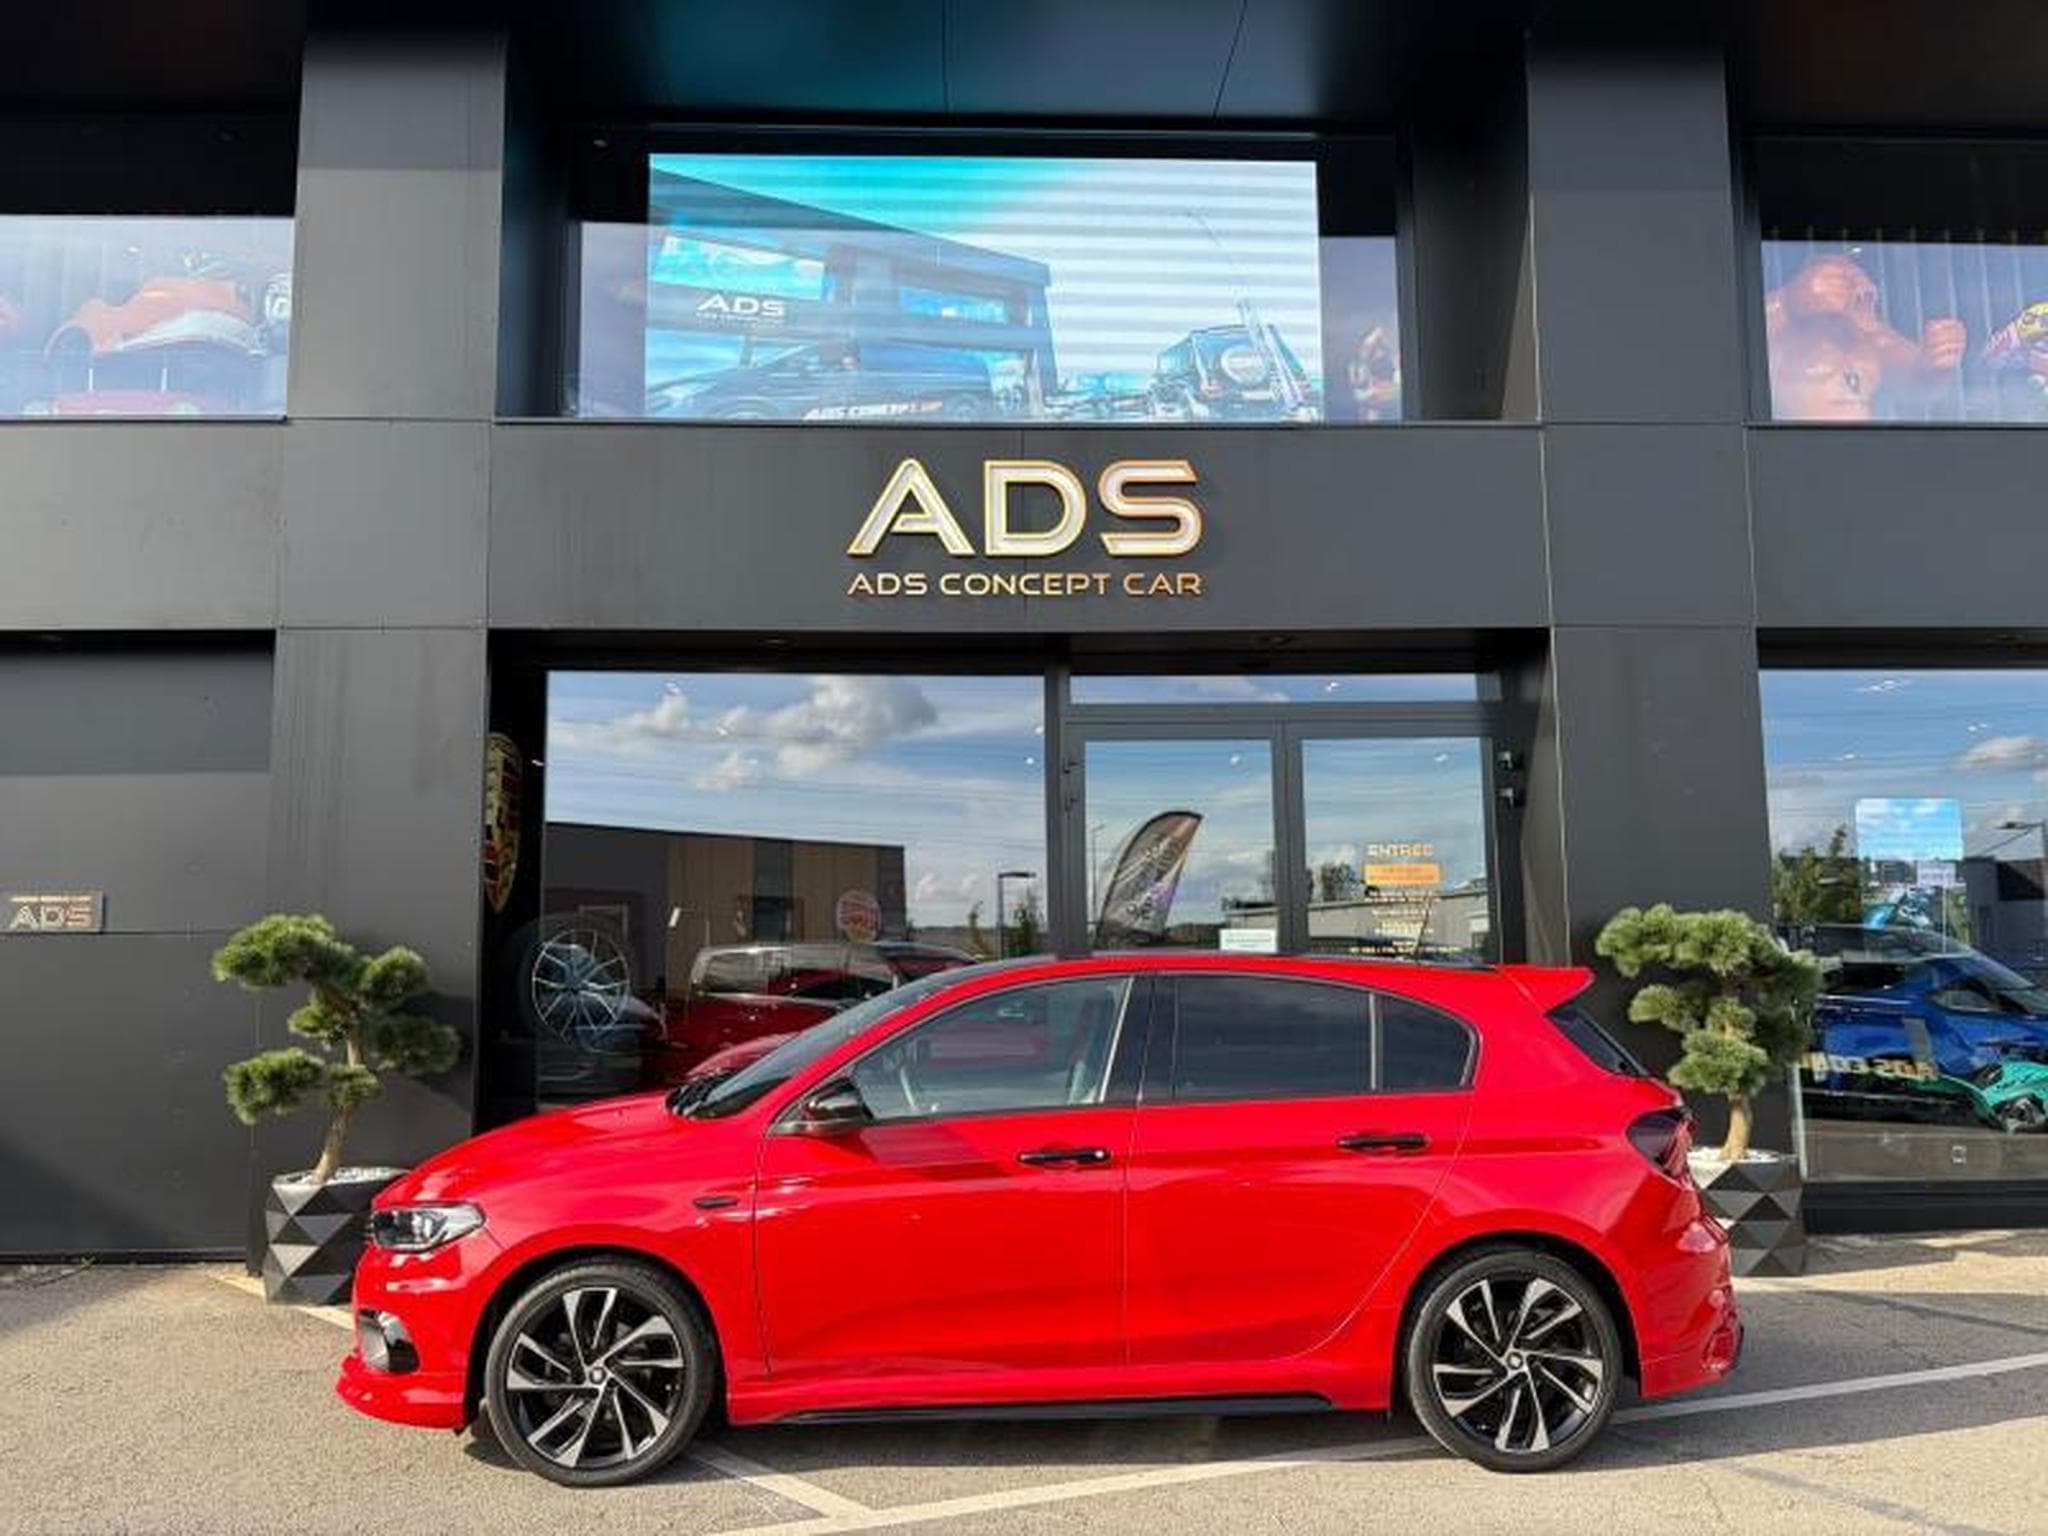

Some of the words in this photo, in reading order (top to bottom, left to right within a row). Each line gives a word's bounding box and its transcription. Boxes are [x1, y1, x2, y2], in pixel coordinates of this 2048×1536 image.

[697, 293, 785, 316] ADS
[846, 458, 1202, 557] ADS
[848, 572, 928, 596] ADS
[939, 572, 1111, 596] CONCEPT
[1122, 572, 1202, 596] CAR
[8, 904, 92, 929] ADS
